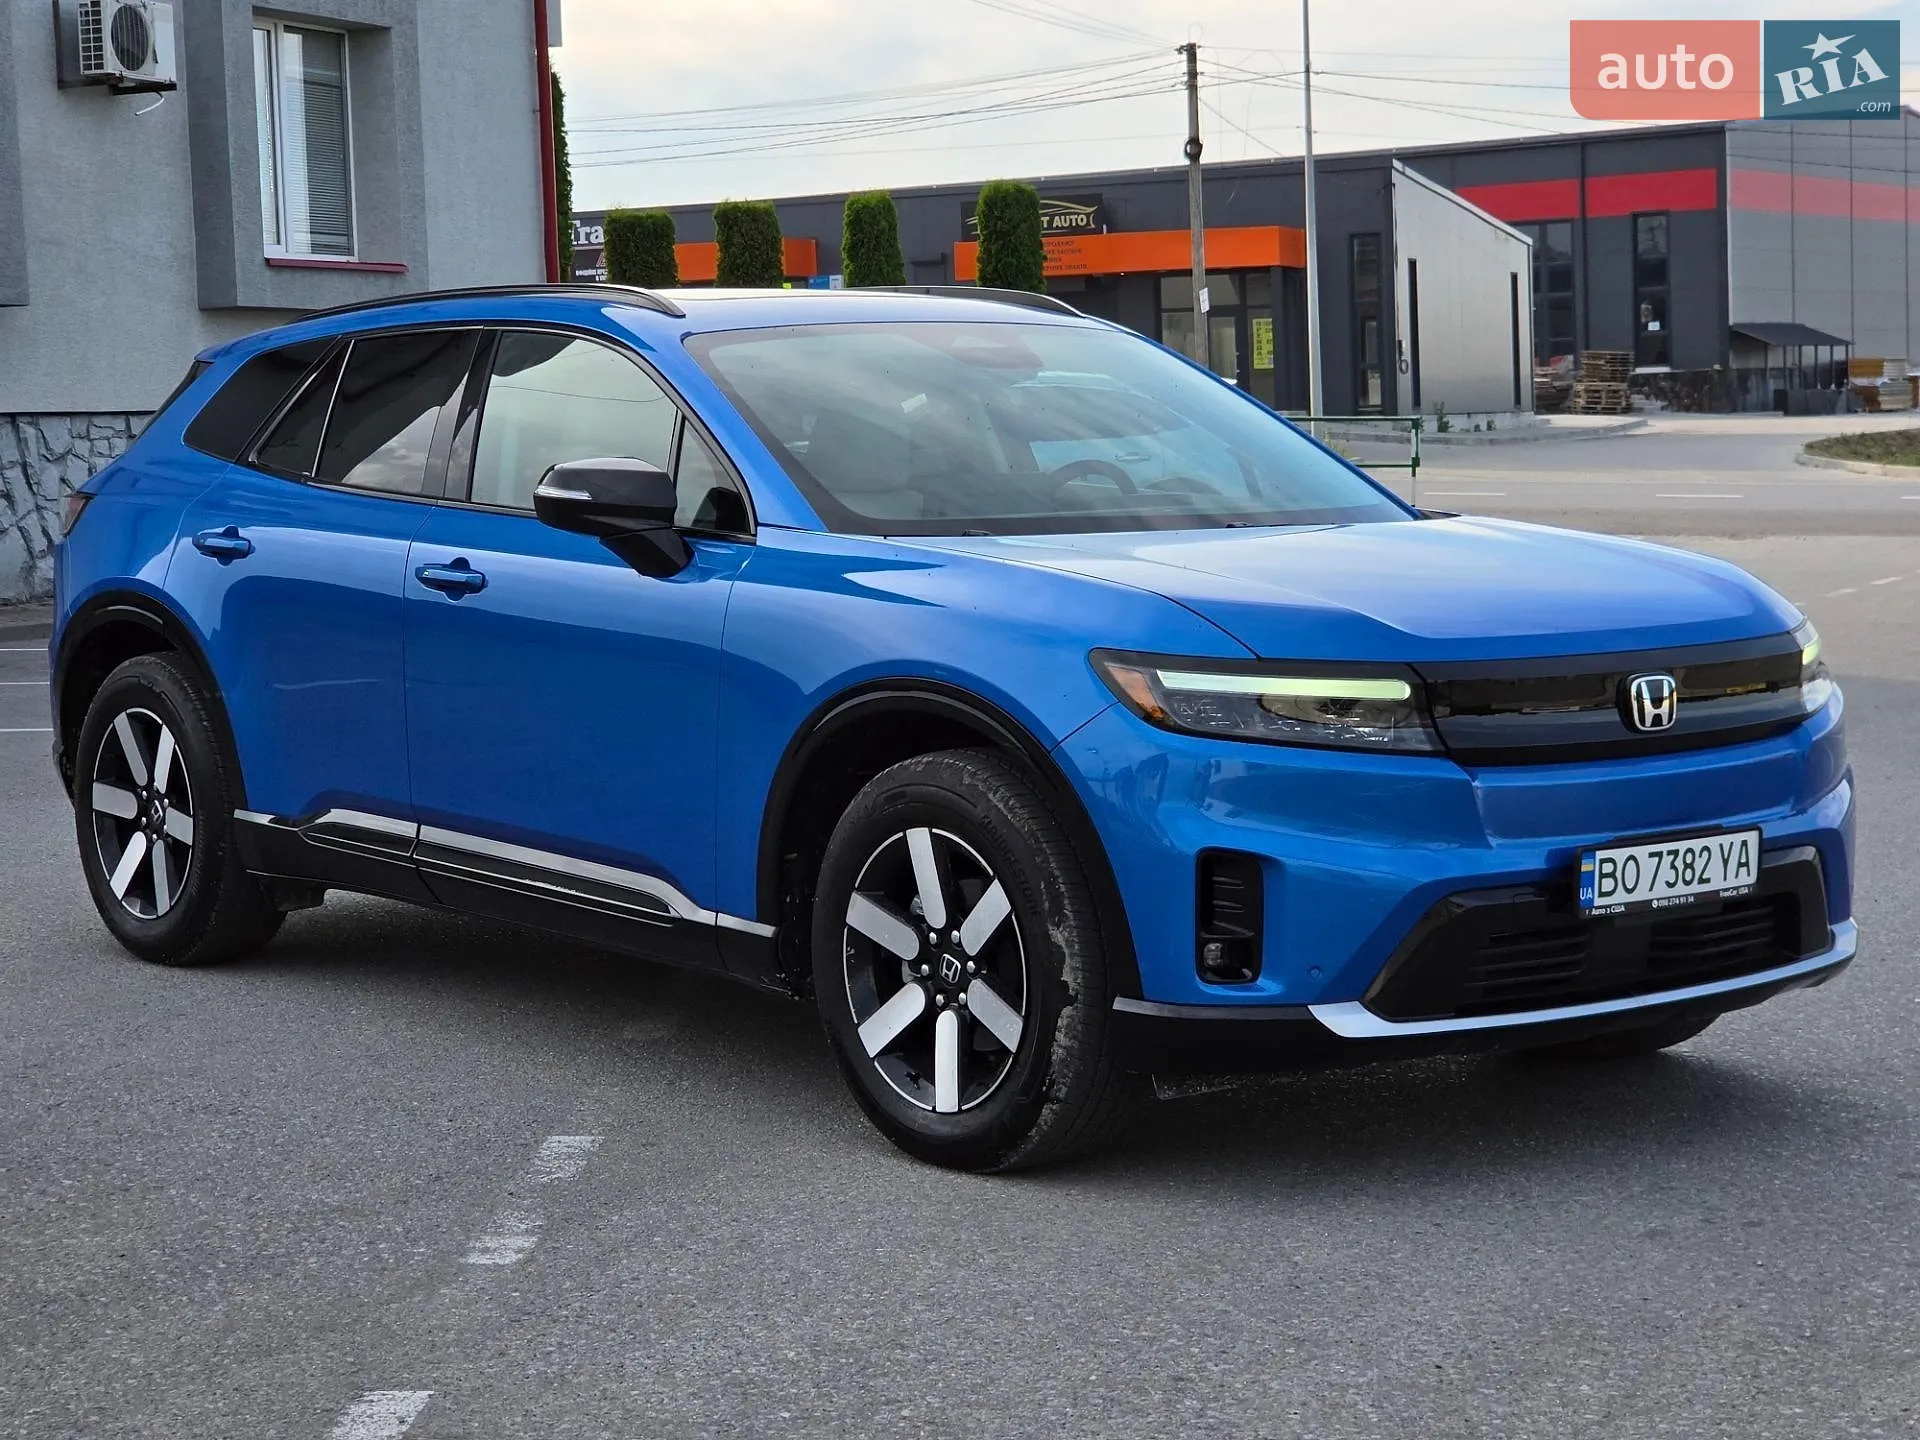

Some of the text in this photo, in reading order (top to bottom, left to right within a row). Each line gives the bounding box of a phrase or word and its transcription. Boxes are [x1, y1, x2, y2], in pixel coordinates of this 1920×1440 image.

[1053, 214, 1087, 228] AUTO
[1597, 839, 1751, 898] BO 7382 YA
[1579, 887, 1593, 900] UA
